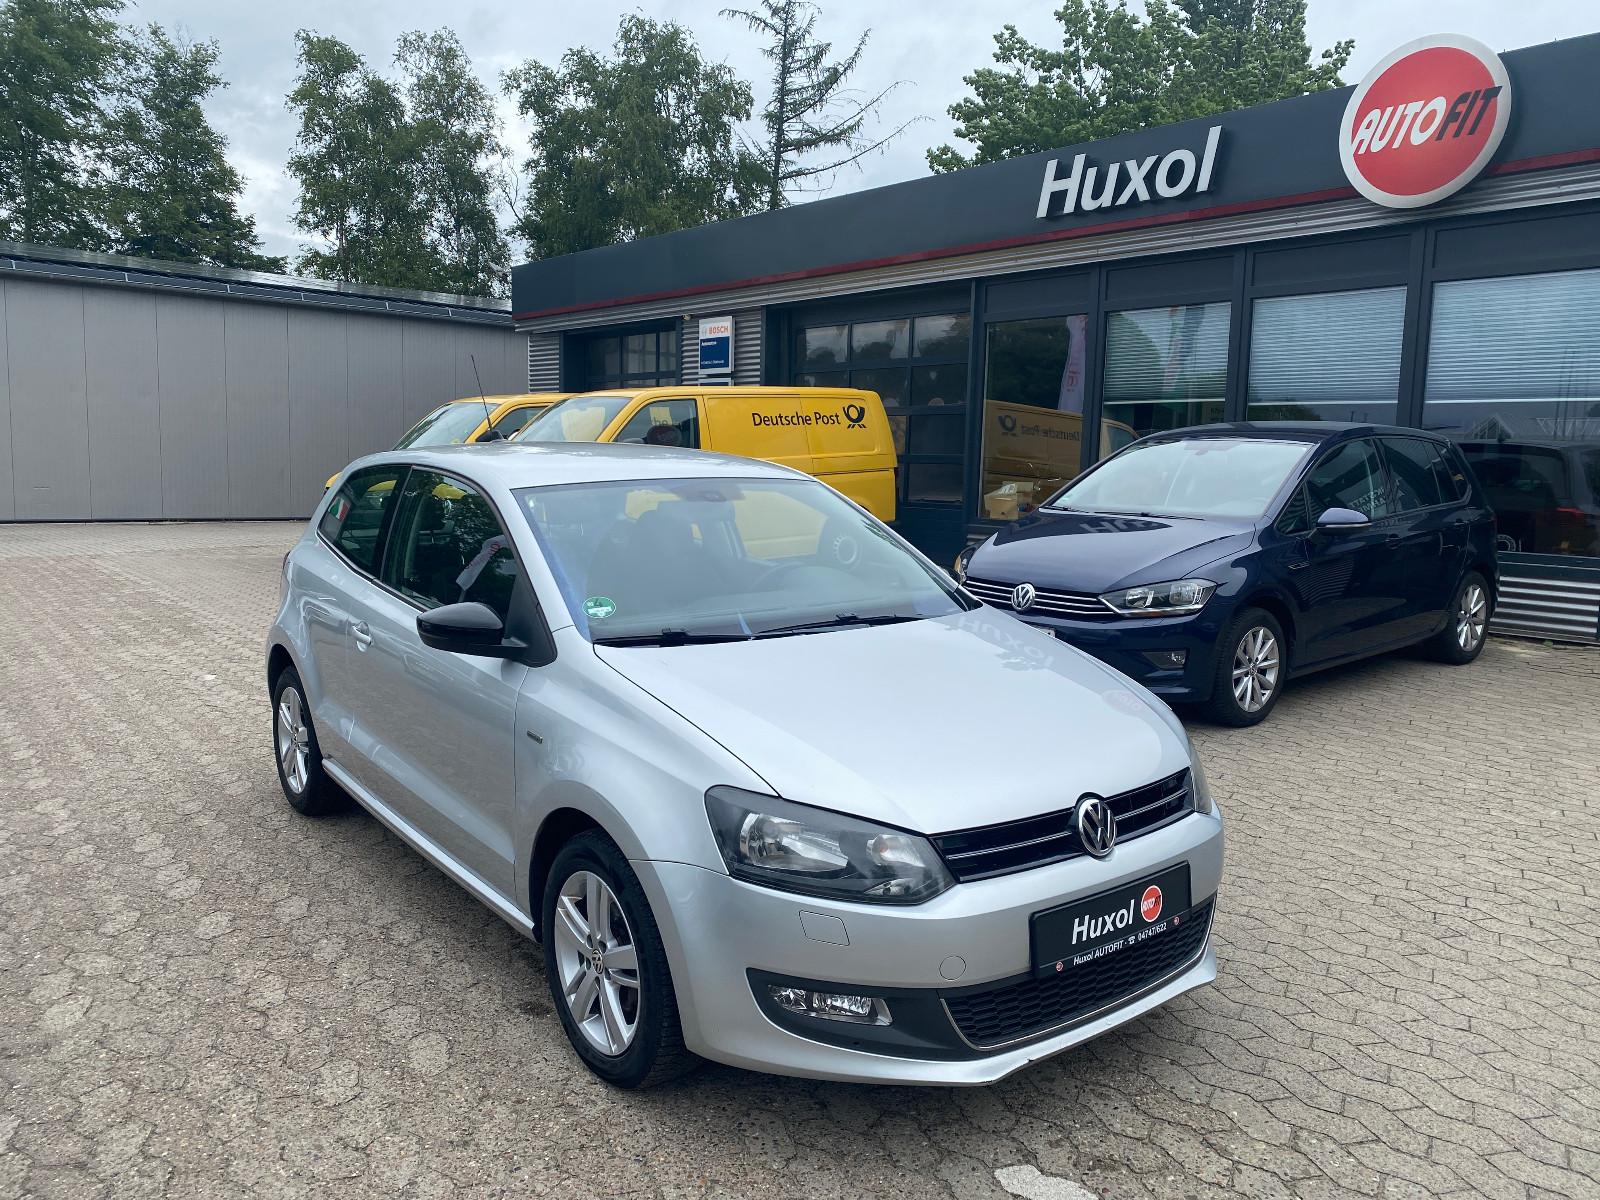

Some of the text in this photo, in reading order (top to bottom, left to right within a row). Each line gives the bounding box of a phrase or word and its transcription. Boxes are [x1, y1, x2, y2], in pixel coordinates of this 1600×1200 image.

[1351, 85, 1503, 157] AUTOFIT
[1036, 125, 1223, 219] Huxol
[708, 325, 729, 335] BOSCH
[751, 411, 841, 427] Deutsche Post
[1079, 797, 1116, 856] VW
[1071, 898, 1135, 945] Huxol
[1073, 922, 1168, 966] Huxol AUTOFIT 04747/622
